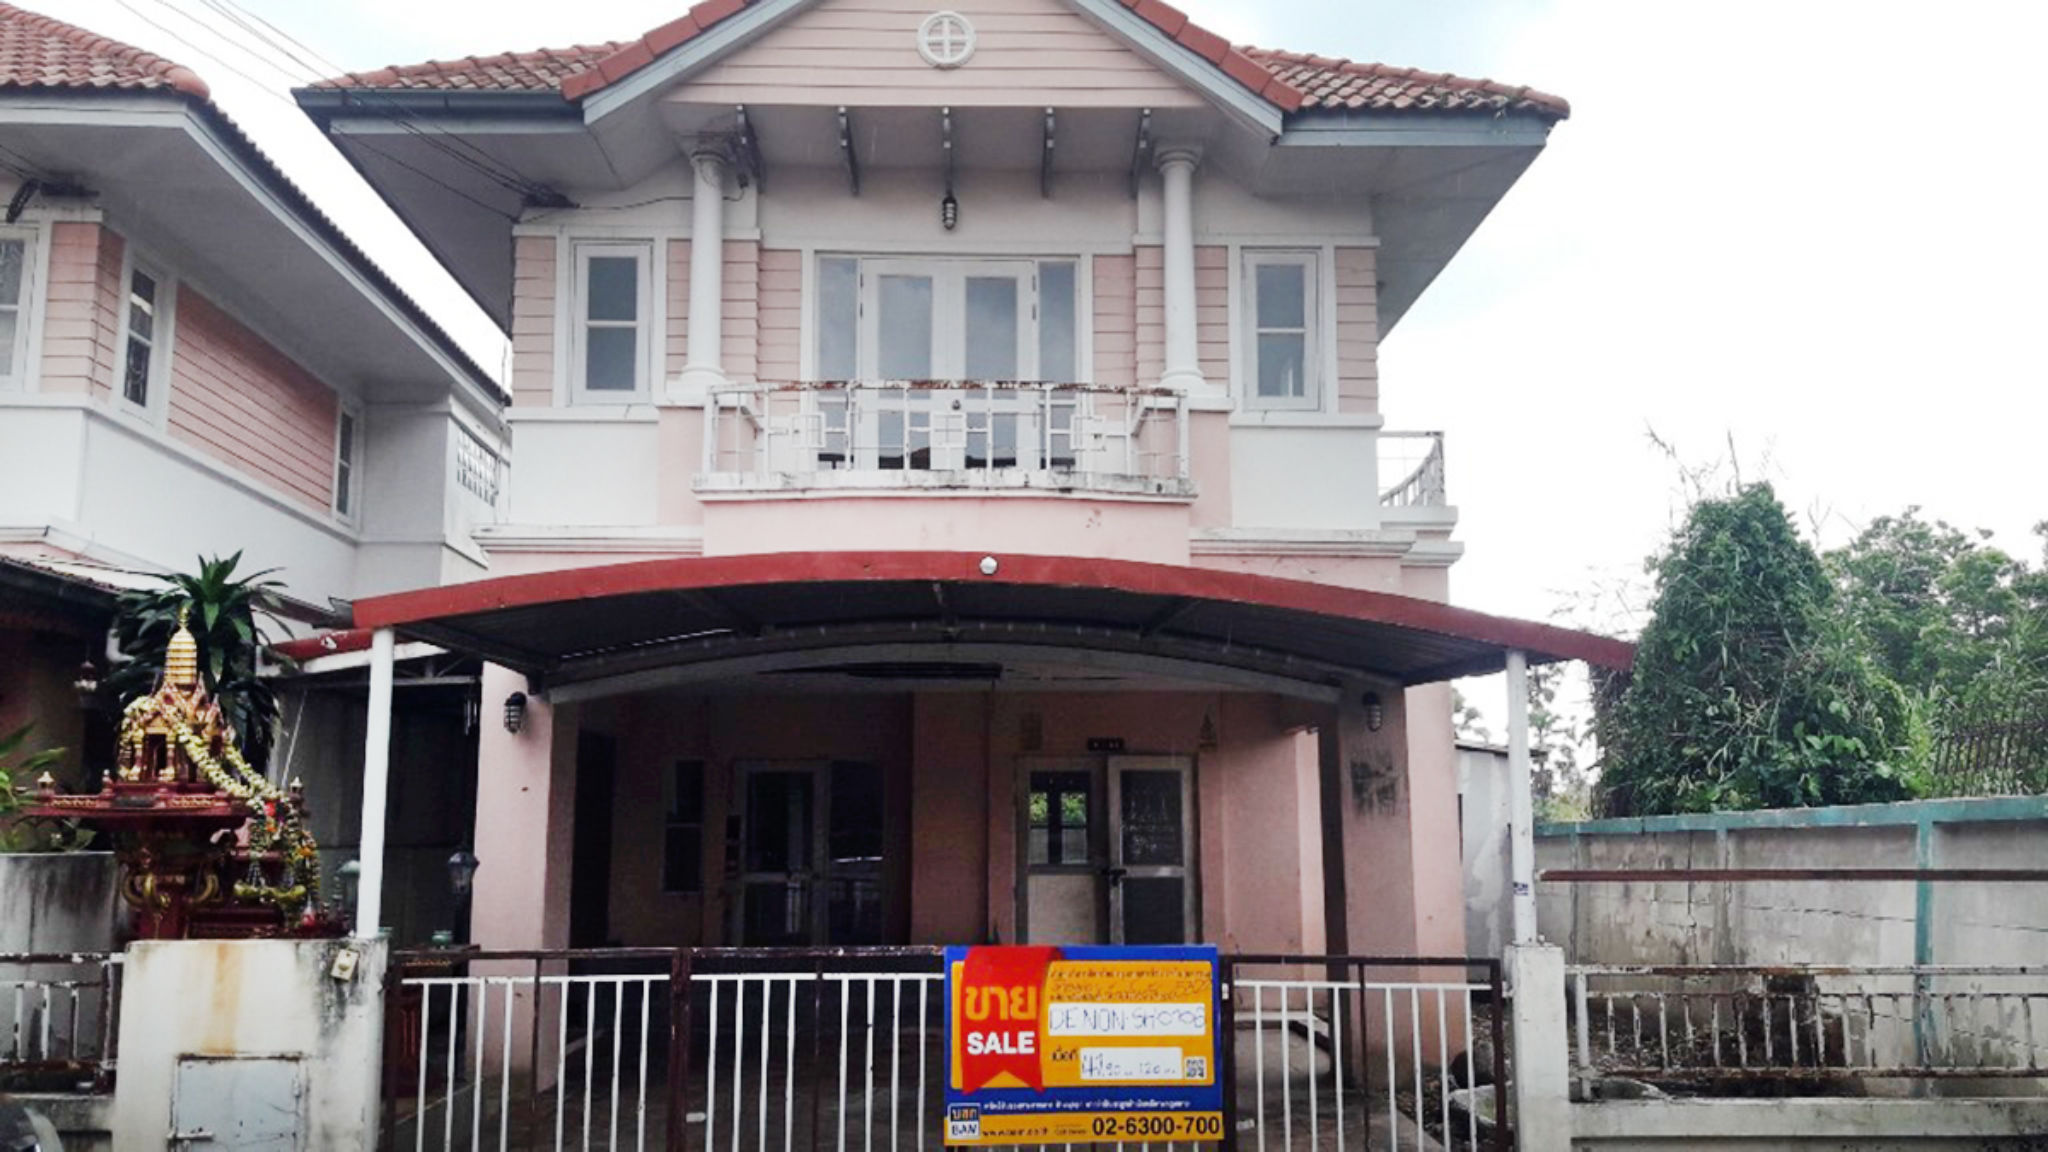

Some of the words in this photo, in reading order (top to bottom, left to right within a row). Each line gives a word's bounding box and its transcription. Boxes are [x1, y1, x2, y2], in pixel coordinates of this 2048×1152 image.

[965, 985, 1037, 1020] ขาย
[967, 1031, 1035, 1055] SALE
[1091, 1116, 1220, 1136] 02-6300-700
